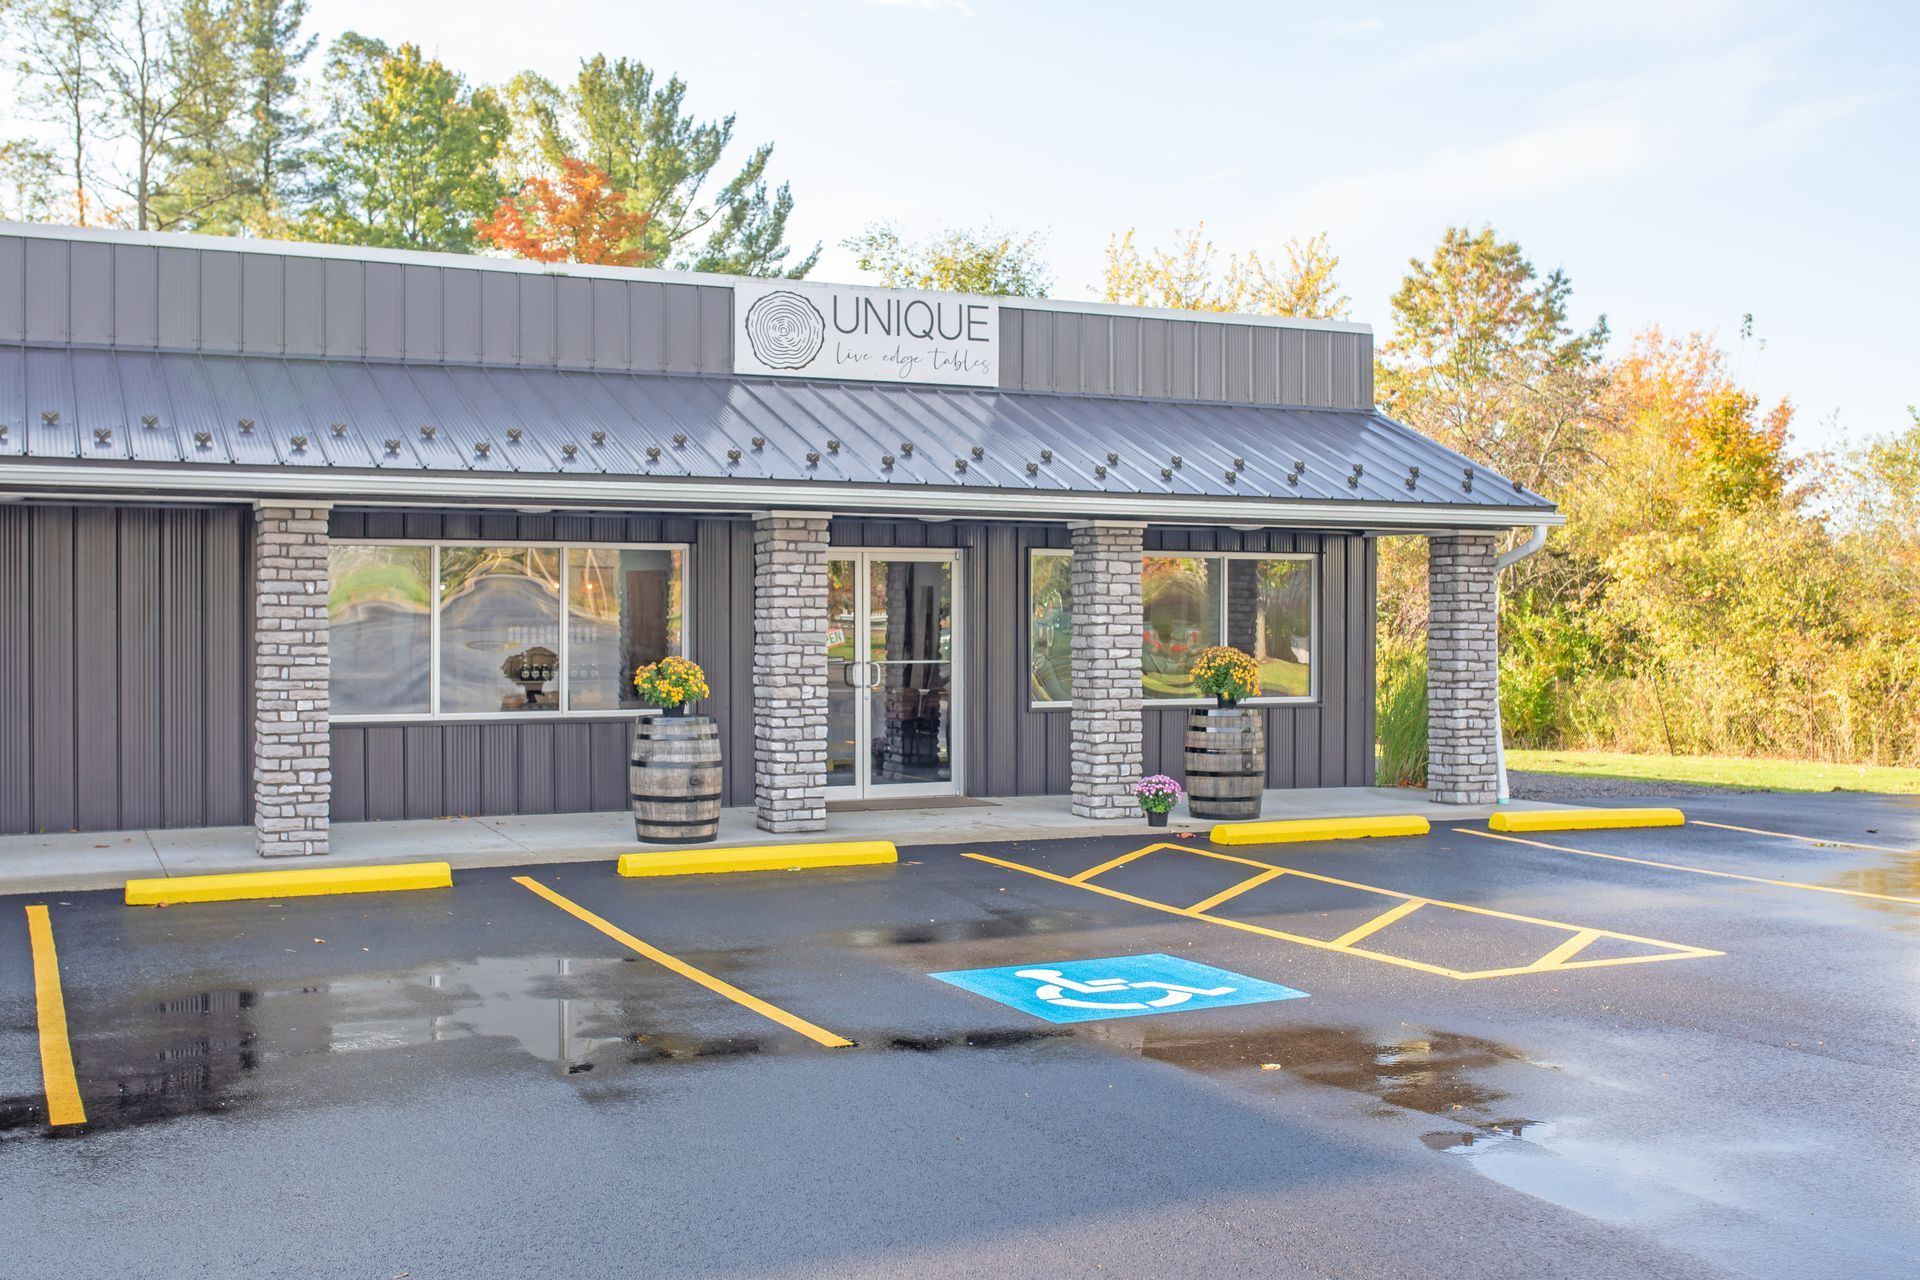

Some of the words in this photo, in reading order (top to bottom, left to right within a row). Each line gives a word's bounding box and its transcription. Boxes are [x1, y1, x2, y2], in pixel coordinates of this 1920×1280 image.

[833, 295, 989, 342] UNIQUE
[836, 341, 872, 365] live
[882, 345, 923, 379] edge
[928, 348, 991, 374] tables
[826, 631, 842, 644] EN
